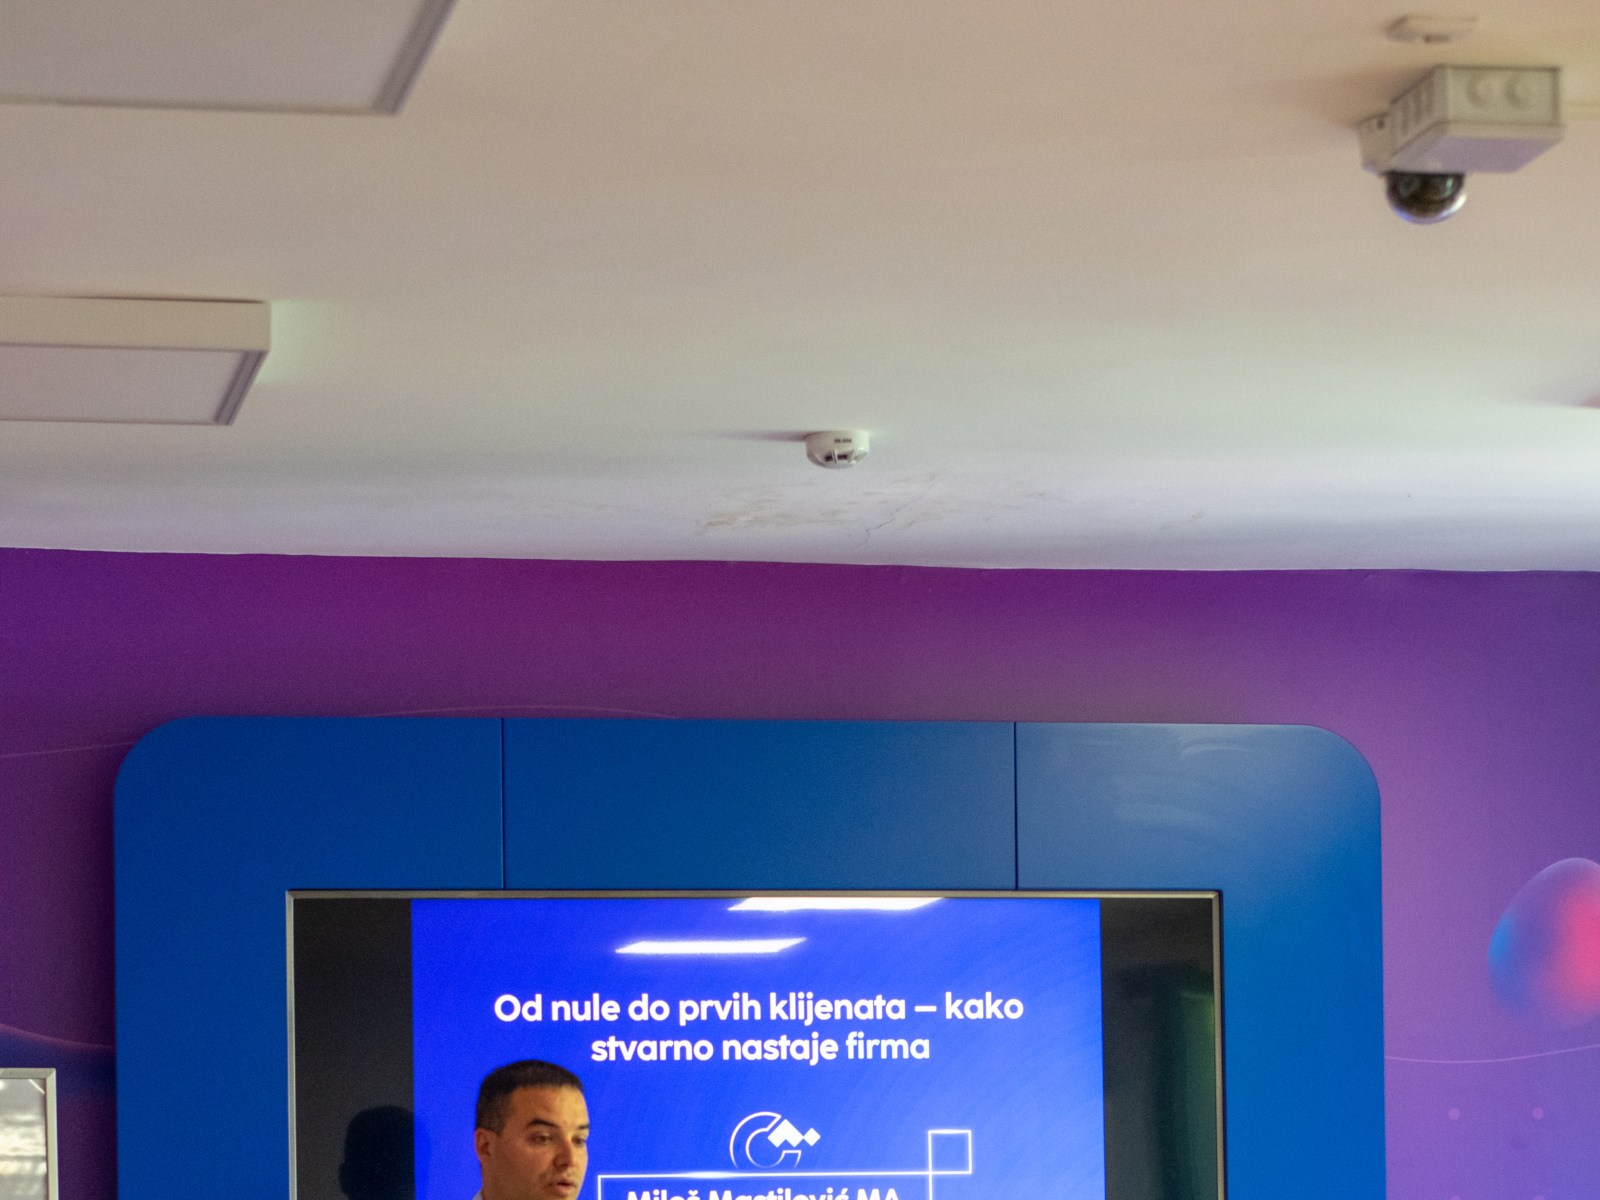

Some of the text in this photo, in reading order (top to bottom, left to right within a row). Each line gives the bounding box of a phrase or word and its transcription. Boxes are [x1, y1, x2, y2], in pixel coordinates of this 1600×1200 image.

[494, 993, 543, 1022] Od
[552, 993, 621, 1022] nule
[628, 992, 671, 1022] do
[679, 991, 762, 1027] prvih
[769, 991, 906, 1027] klijenata
[944, 991, 1025, 1020] kako
[591, 1033, 931, 1067] stvarno nastaje firma
